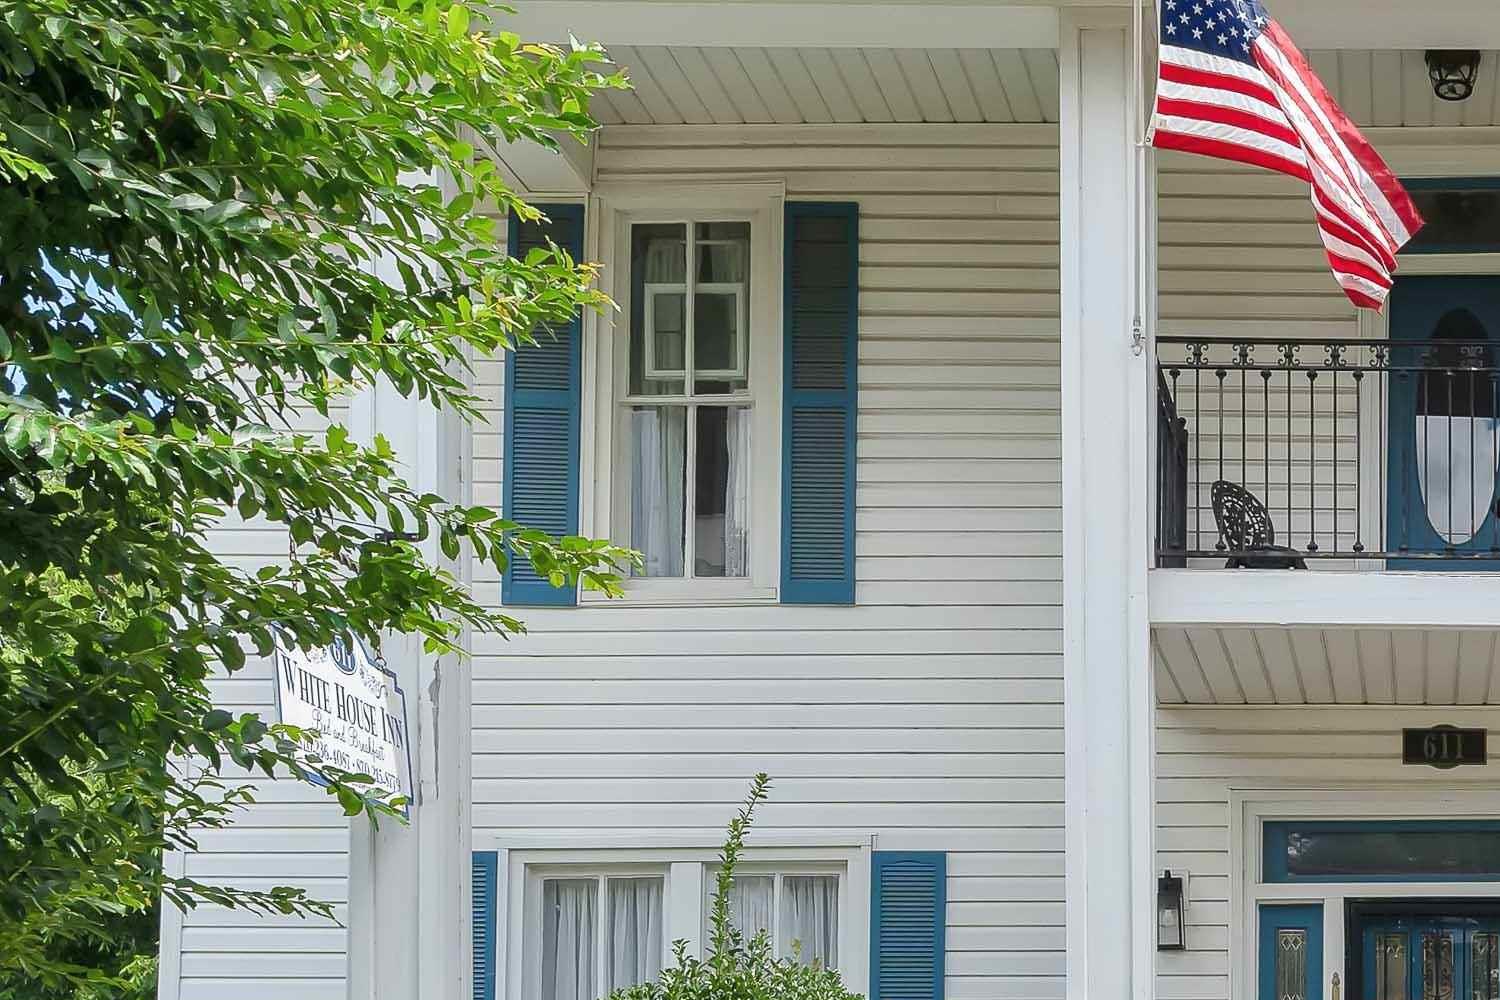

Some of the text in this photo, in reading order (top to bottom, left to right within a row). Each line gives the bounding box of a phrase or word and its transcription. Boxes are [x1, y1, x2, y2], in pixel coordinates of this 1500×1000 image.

[281, 654, 403, 749] WHITE HOUSE INN
[312, 708, 331, 736] Bed
[347, 726, 385, 764] Breakfast
[1424, 733, 1464, 760] 611
